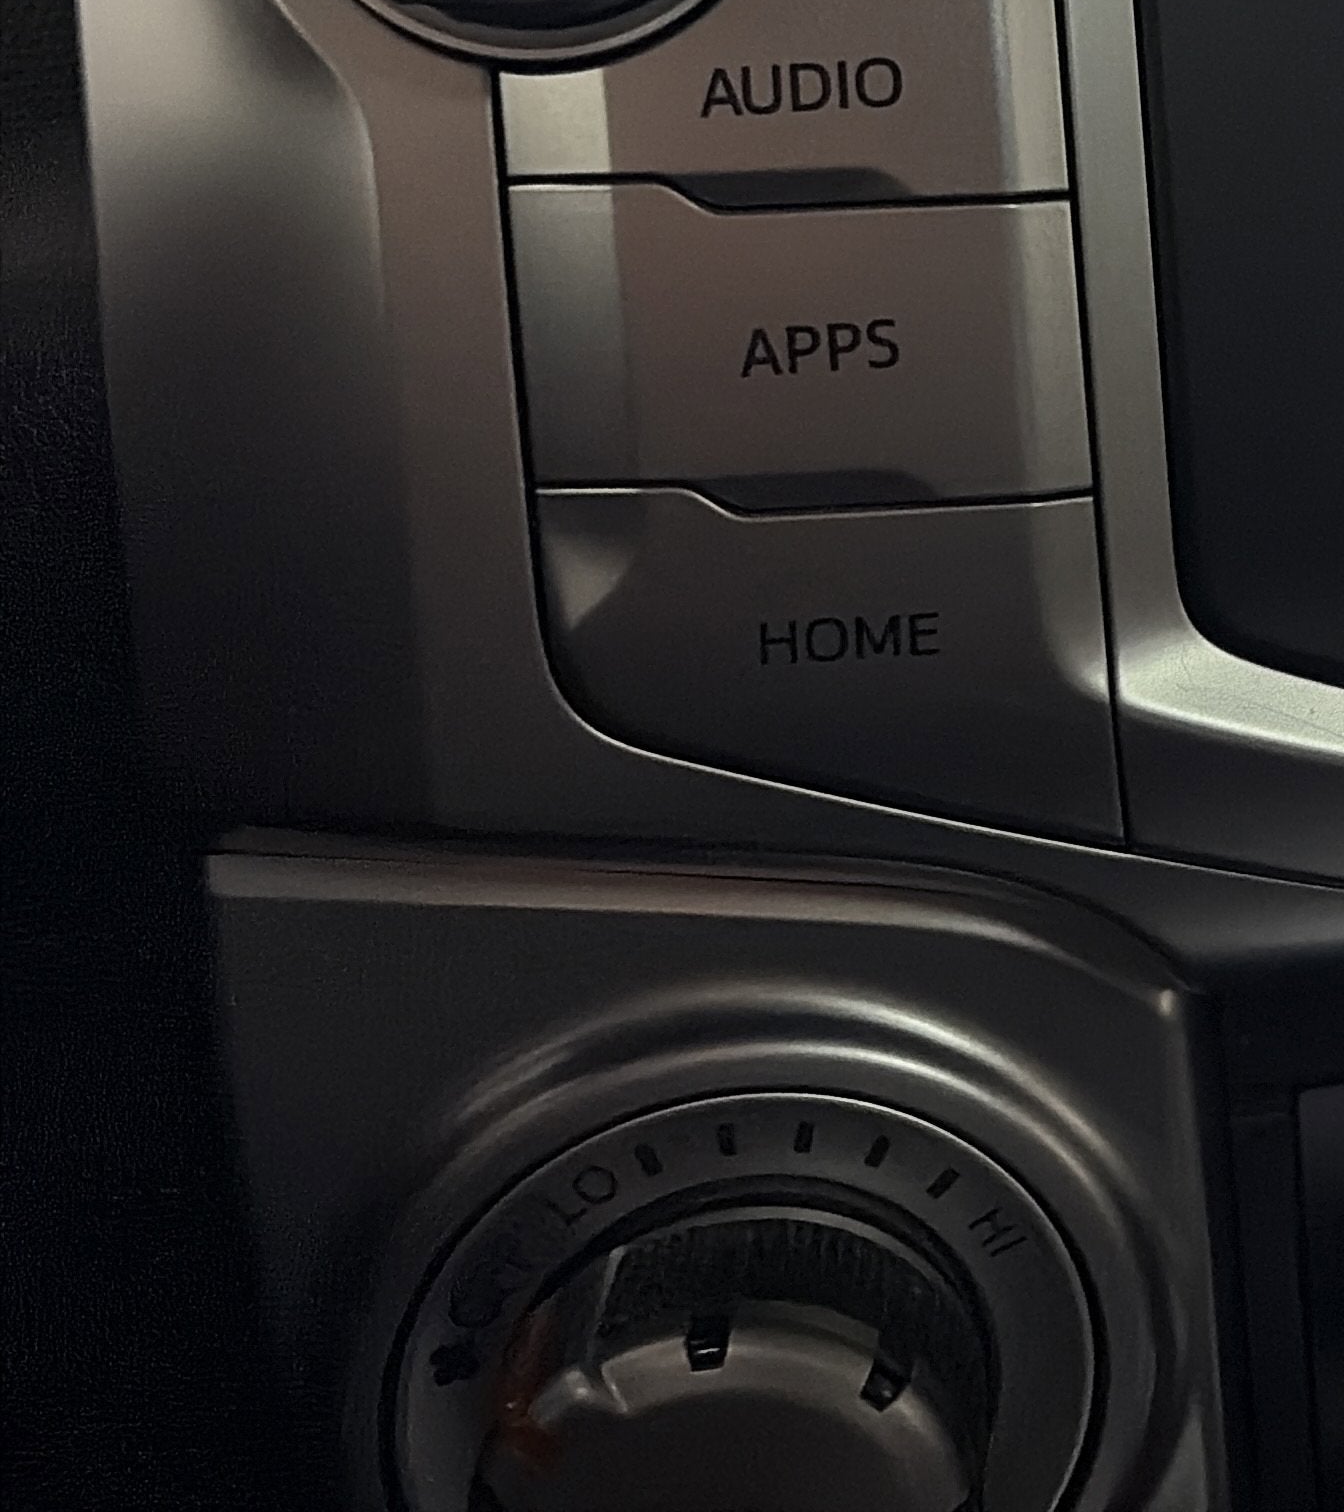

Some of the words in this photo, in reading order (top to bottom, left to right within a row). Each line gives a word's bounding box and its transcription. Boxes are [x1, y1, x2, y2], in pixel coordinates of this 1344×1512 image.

[700, 57, 902, 119] AUDIO
[740, 318, 900, 378] APPS
[757, 612, 941, 666] HOME
[545, 1165, 617, 1228] LO
[966, 1207, 1028, 1258] HI
